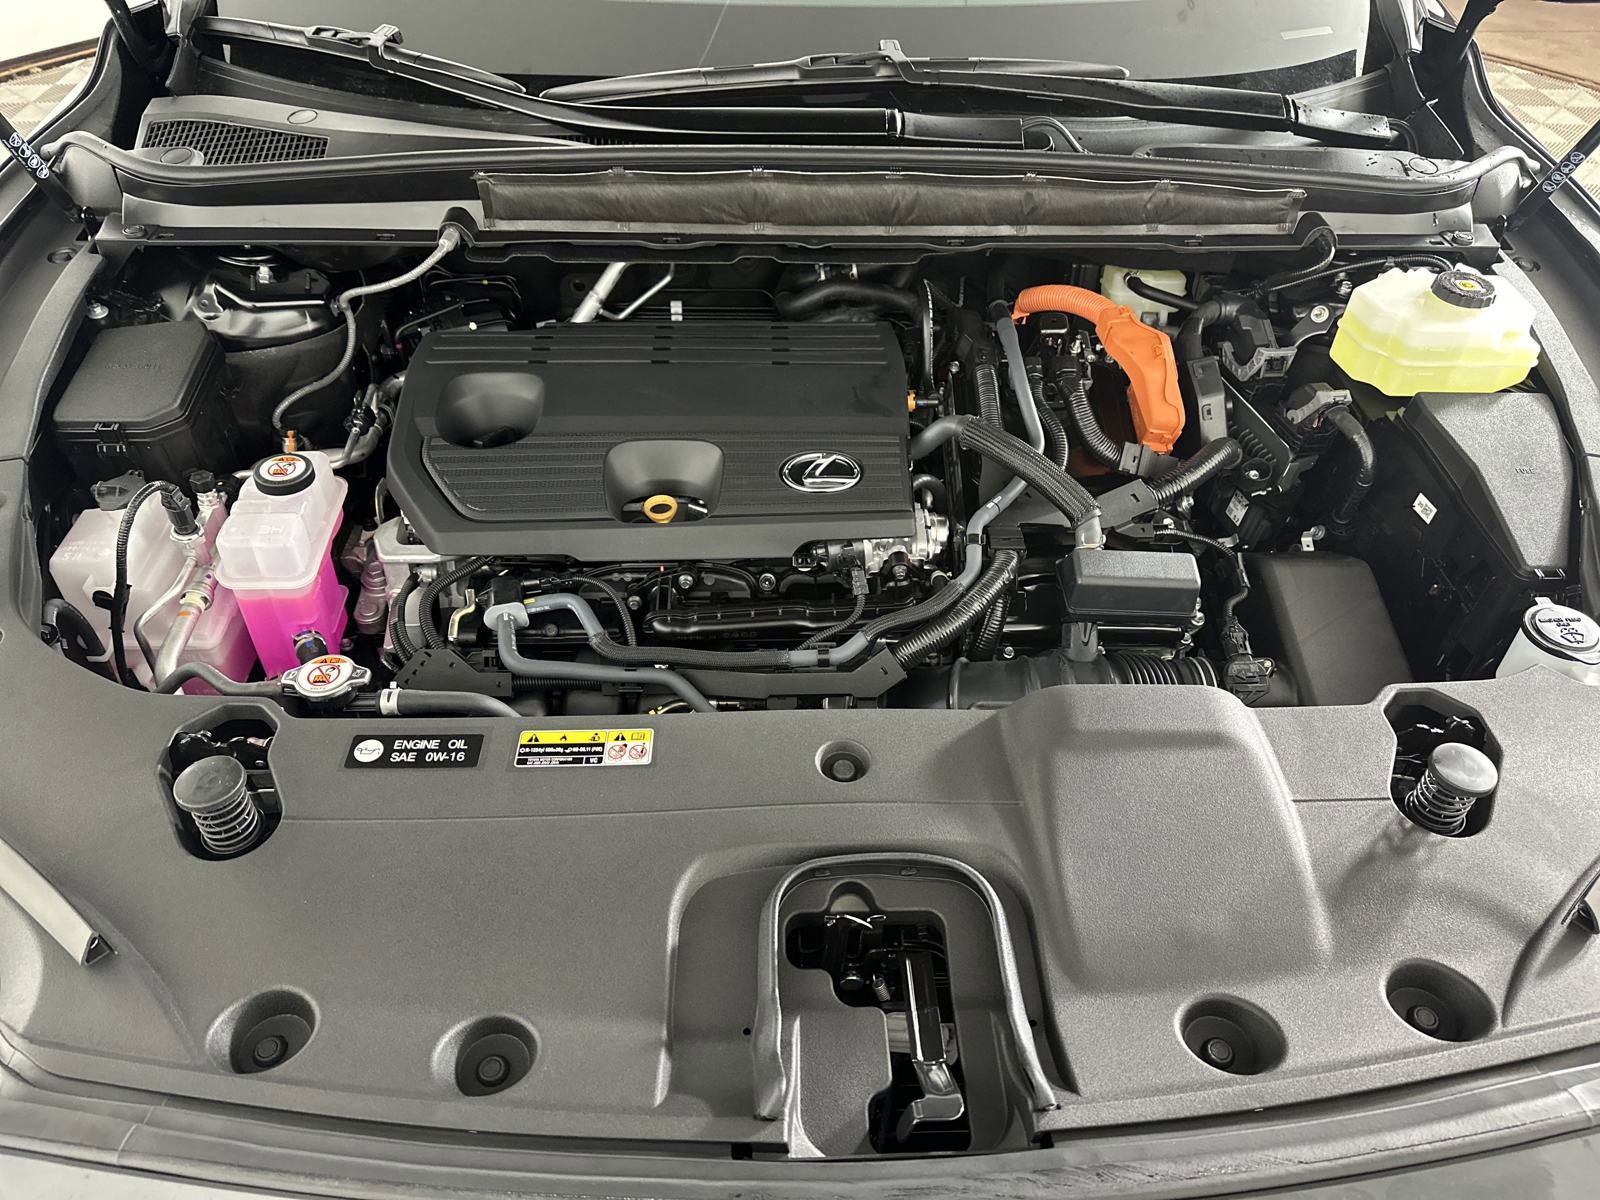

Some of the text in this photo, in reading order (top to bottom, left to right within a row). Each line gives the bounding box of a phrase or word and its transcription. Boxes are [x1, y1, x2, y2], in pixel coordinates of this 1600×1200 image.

[393, 739, 468, 750] ENGINE OIL
[389, 751, 466, 762] SAE 0W-16
